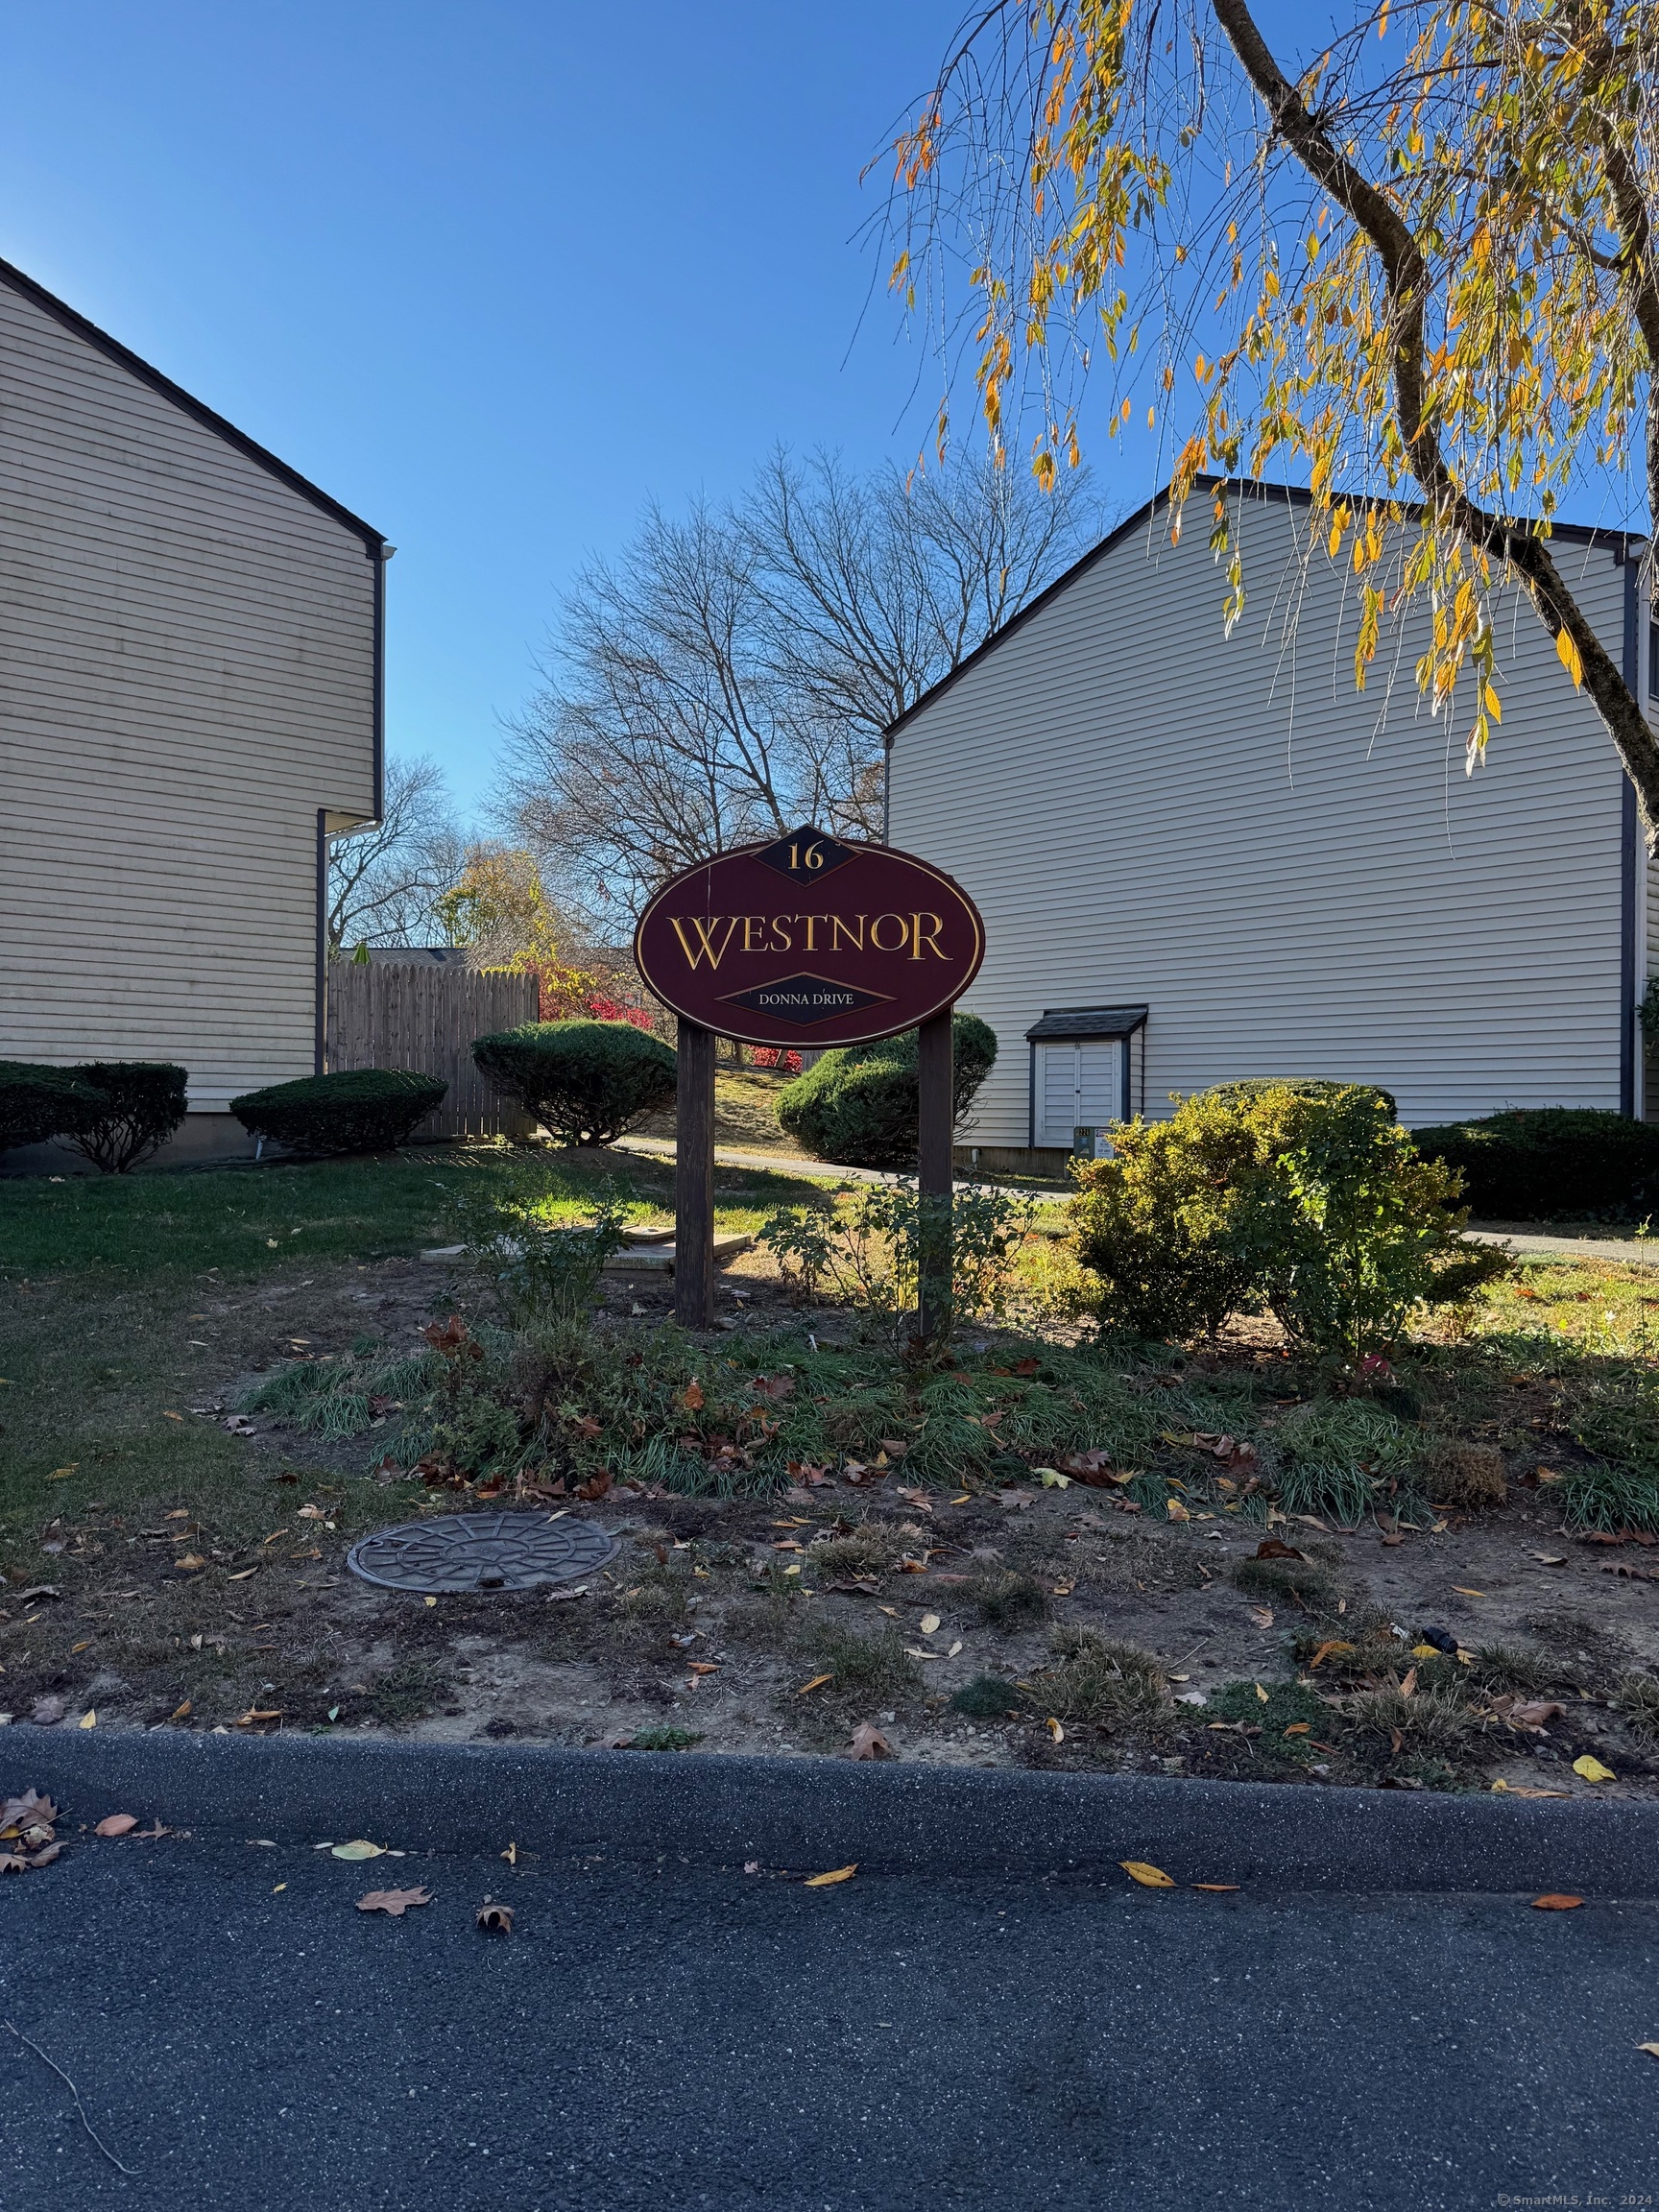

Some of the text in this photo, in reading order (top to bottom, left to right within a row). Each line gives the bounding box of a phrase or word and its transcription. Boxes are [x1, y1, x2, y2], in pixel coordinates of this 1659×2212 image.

[787, 840, 824, 870] 16
[666, 912, 953, 971] WESTNOR
[758, 993, 854, 1005] DONNA DRIVE
